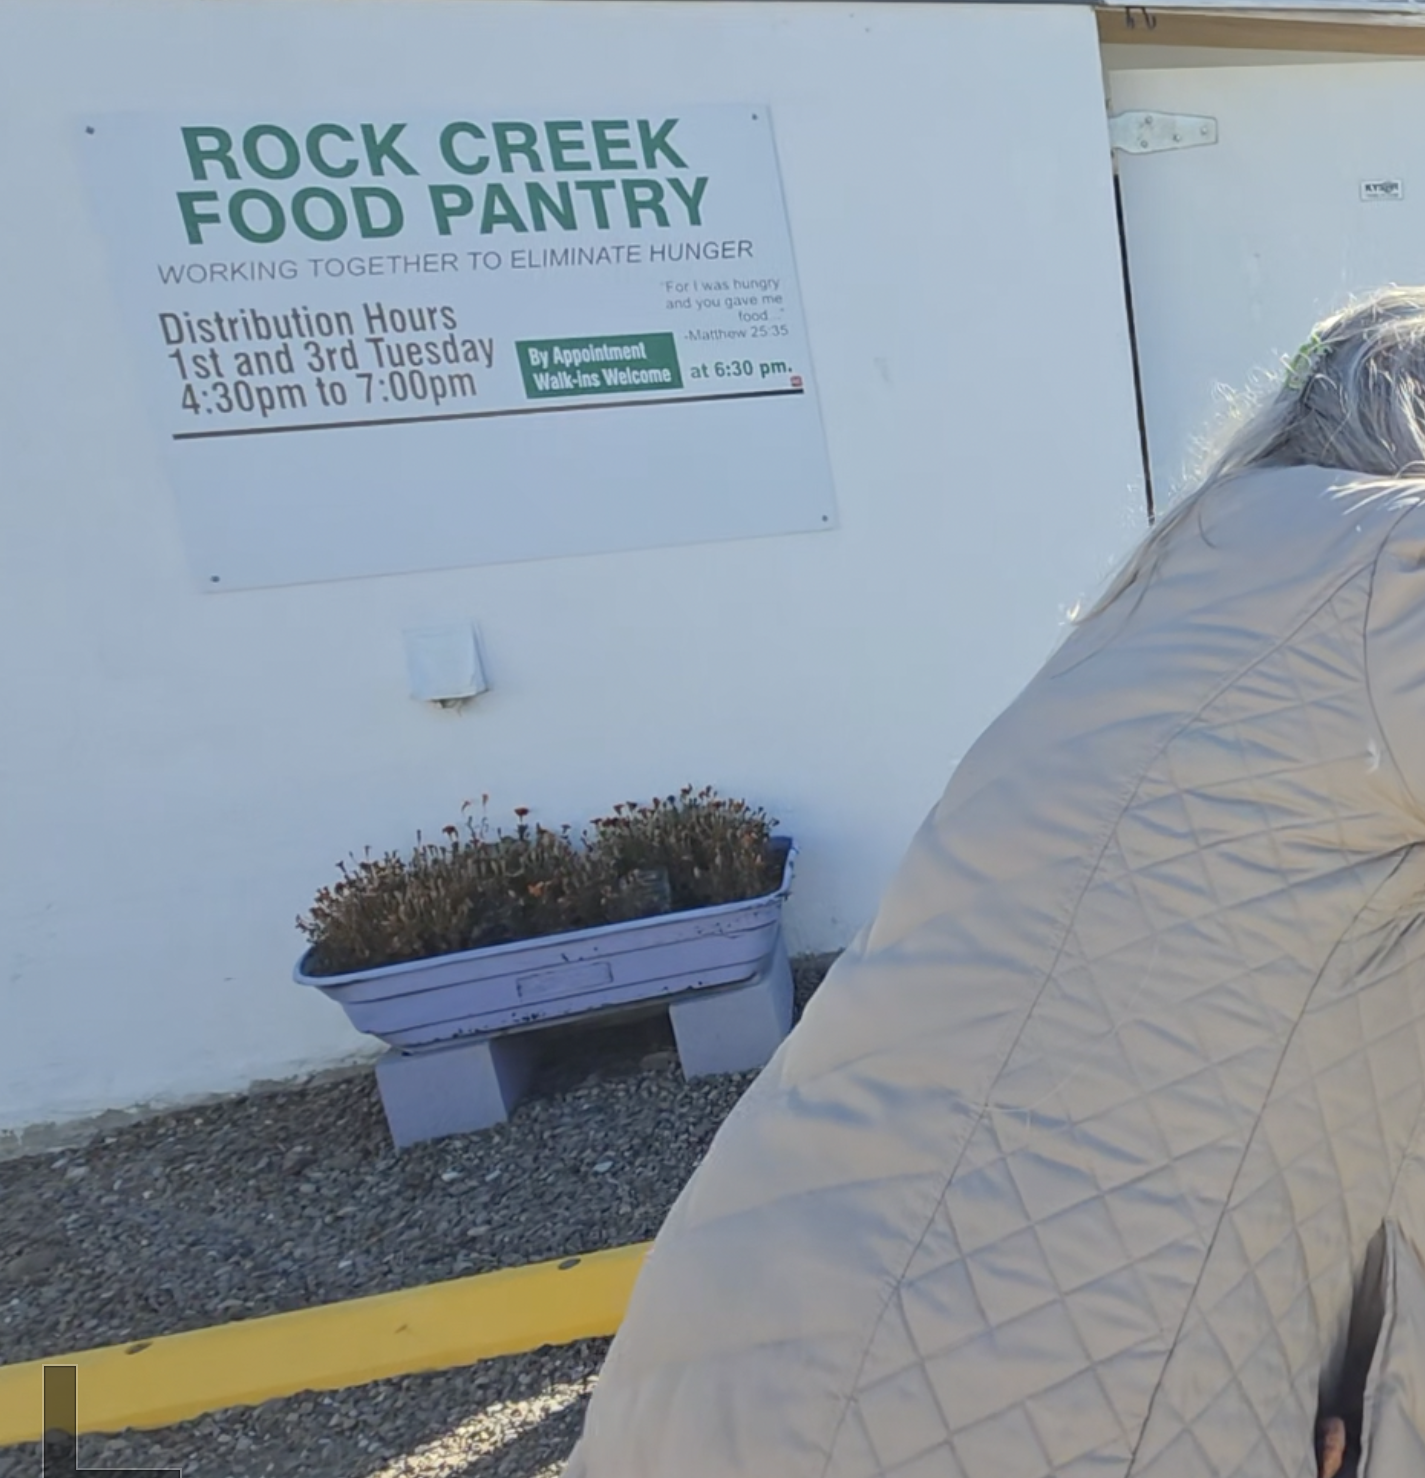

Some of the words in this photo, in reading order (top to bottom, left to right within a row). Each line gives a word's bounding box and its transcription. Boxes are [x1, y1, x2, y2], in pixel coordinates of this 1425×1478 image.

[180, 123, 420, 180] ROCK
[439, 118, 689, 175] CREEK
[176, 186, 404, 244] FOOD
[428, 176, 709, 235] PANTRY
[157, 260, 298, 285] WORKING
[308, 253, 458, 278] TOGETHER
[467, 250, 502, 271] TO
[511, 244, 642, 269] ELIMINATE
[650, 239, 754, 262] HUNGER
[702, 280, 730, 292] was
[732, 278, 780, 291] hungry
[665, 297, 692, 310] and
[695, 298, 721, 312] you
[724, 295, 758, 309] gave
[762, 294, 783, 305] me
[159, 306, 354, 345] Distribution
[362, 302, 457, 335] Hours
[750, 324, 789, 339] 25:35
[168, 348, 224, 380] 1st
[234, 343, 294, 377] and
[304, 339, 359, 374] 3rd
[365, 333, 494, 369] Tuesday
[527, 347, 549, 369] By
[552, 341, 647, 367] Appointment
[690, 363, 709, 379] at
[714, 359, 754, 378] 6:30
[760, 359, 793, 378] pm.
[181, 380, 307, 418] 4:30pm
[316, 377, 347, 406] to
[356, 369, 477, 406] 7:00pm
[533, 371, 600, 391] Walk-ins
[601, 366, 672, 387] Welcome
